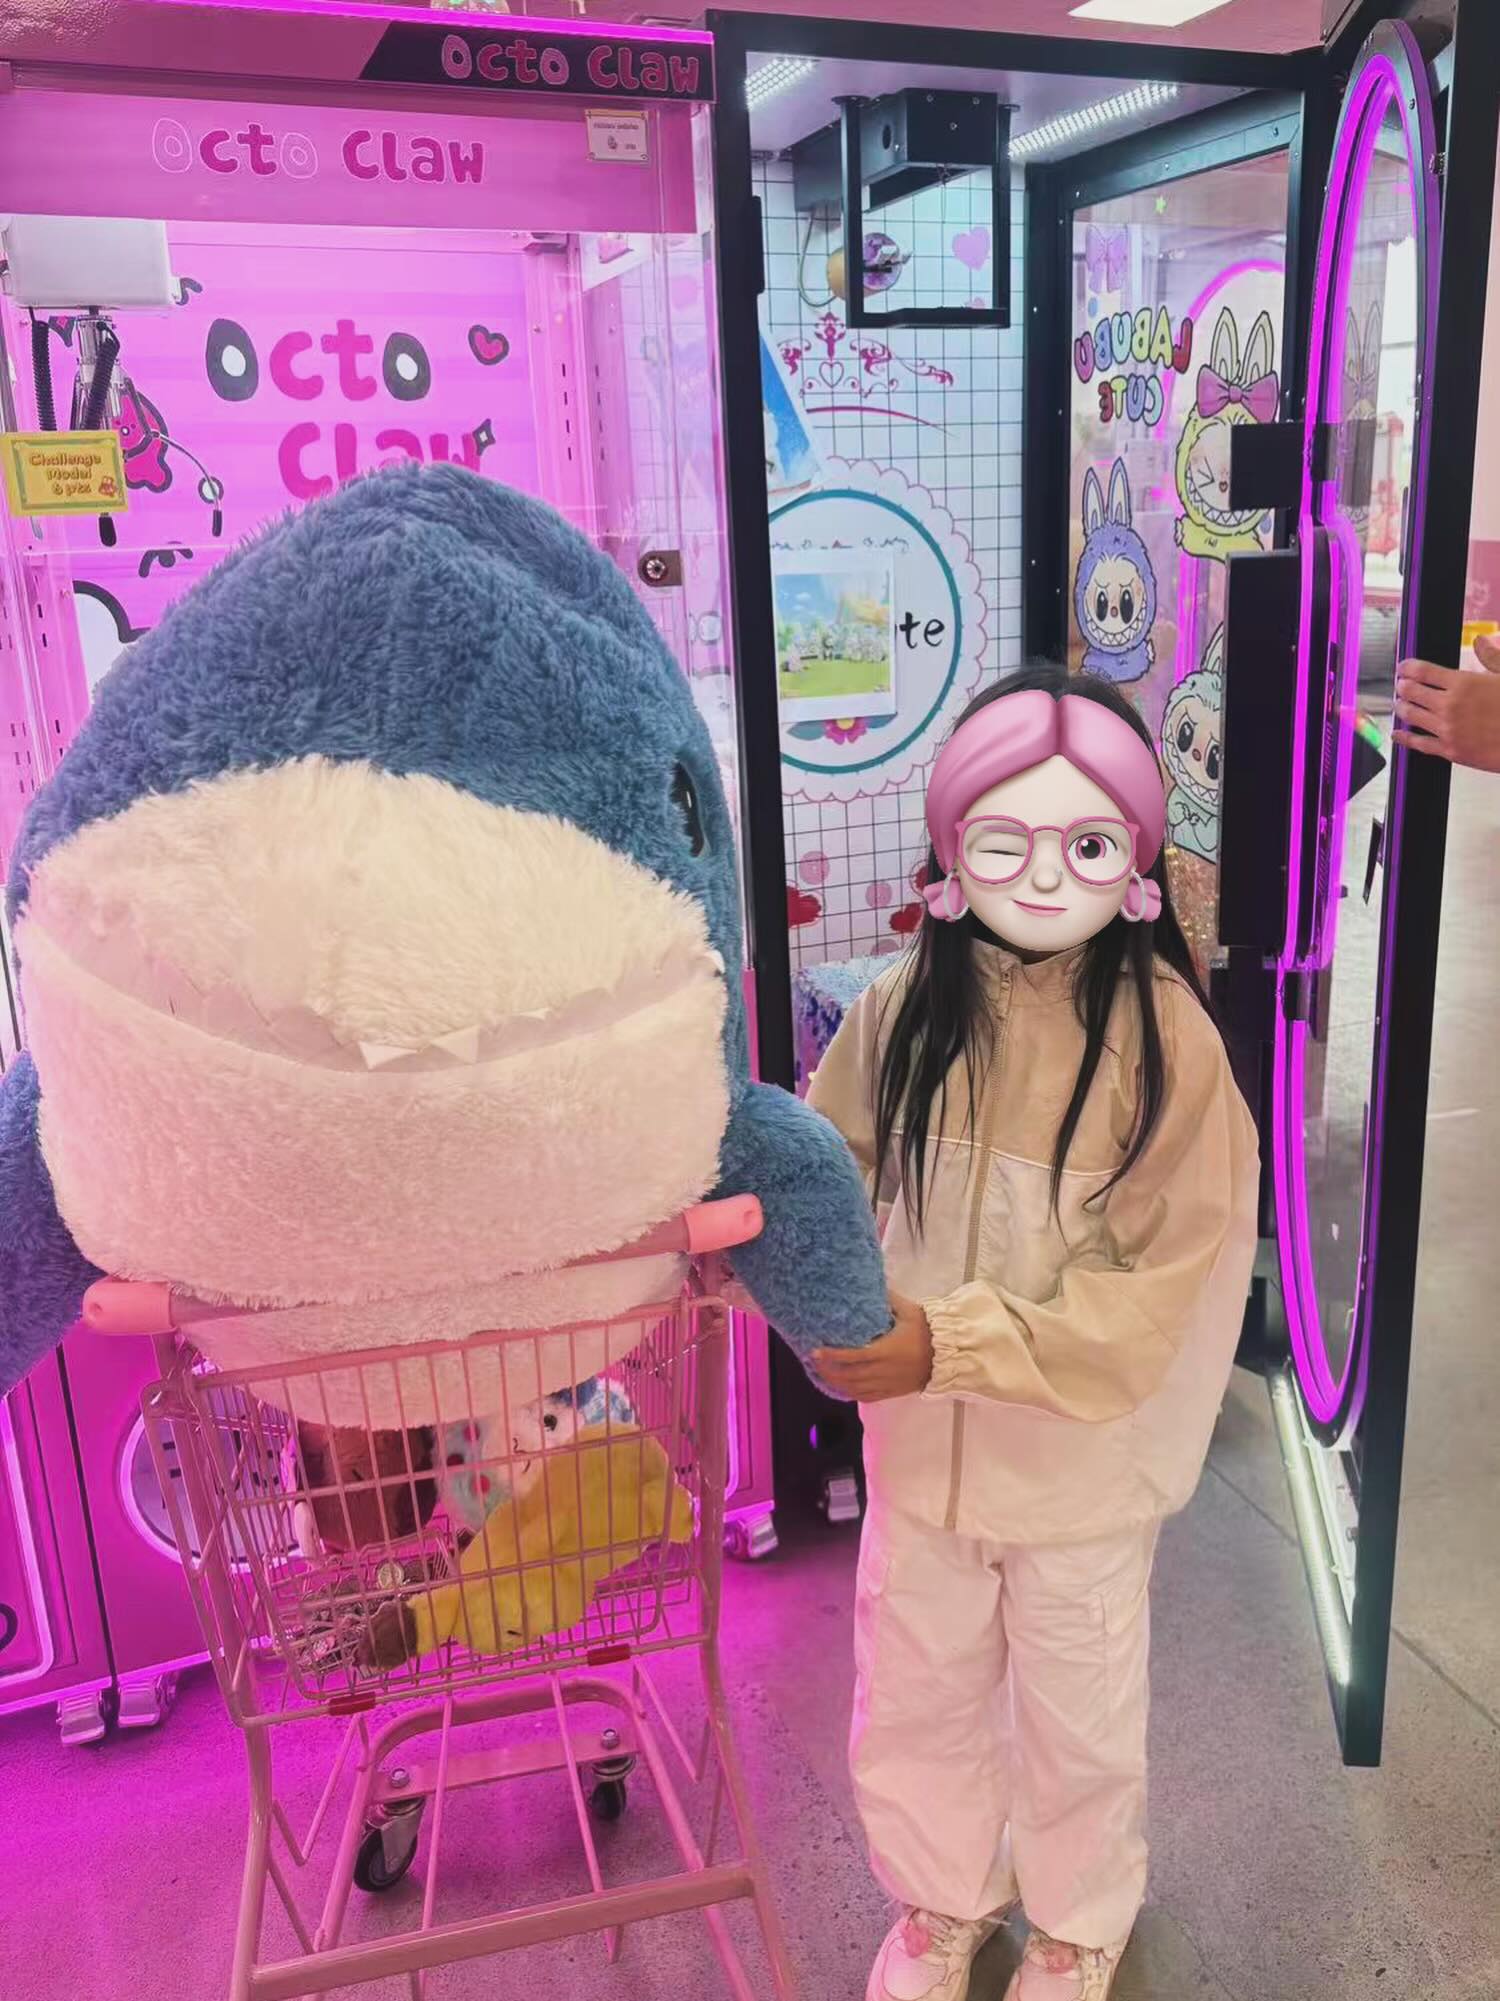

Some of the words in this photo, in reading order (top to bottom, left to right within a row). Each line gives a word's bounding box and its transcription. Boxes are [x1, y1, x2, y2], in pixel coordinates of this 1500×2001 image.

[441, 34, 570, 85] Octo
[586, 45, 700, 93] Claw
[152, 118, 319, 179] Octo
[341, 129, 486, 184] Claw
[205, 318, 431, 401] Octo
[29, 453, 102, 467] Challenge
[894, 611, 945, 649] te
